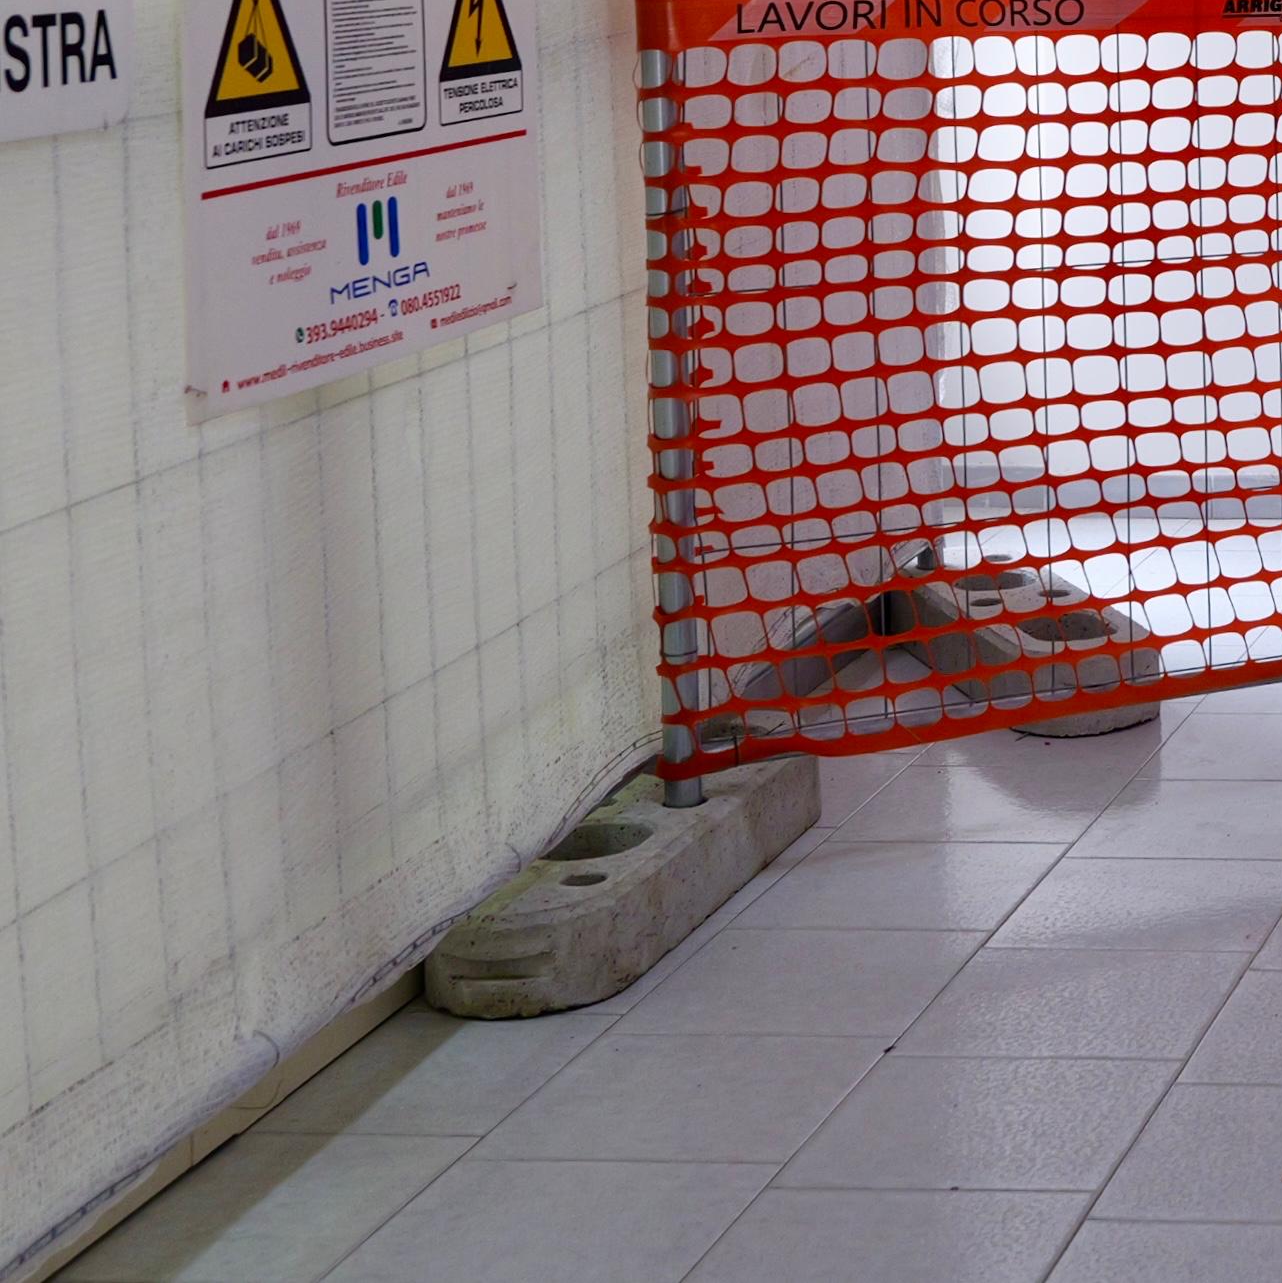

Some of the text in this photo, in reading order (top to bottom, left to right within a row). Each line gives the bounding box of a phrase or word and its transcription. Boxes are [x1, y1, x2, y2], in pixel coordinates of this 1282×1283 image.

[736, 0, 887, 35] LAVORI
[4, 9, 117, 92] STRA
[444, 78, 518, 100] TENSIONE ELETTRICA
[459, 98, 503, 115] PERICOLOSA
[228, 114, 289, 136] ATTENZIONE
[224, 130, 305, 156] CARICHI SOSPESI
[330, 262, 430, 304] MENGA
[306, 312, 378, 344] 393.9440294
[401, 284, 461, 315] 080.4551922
